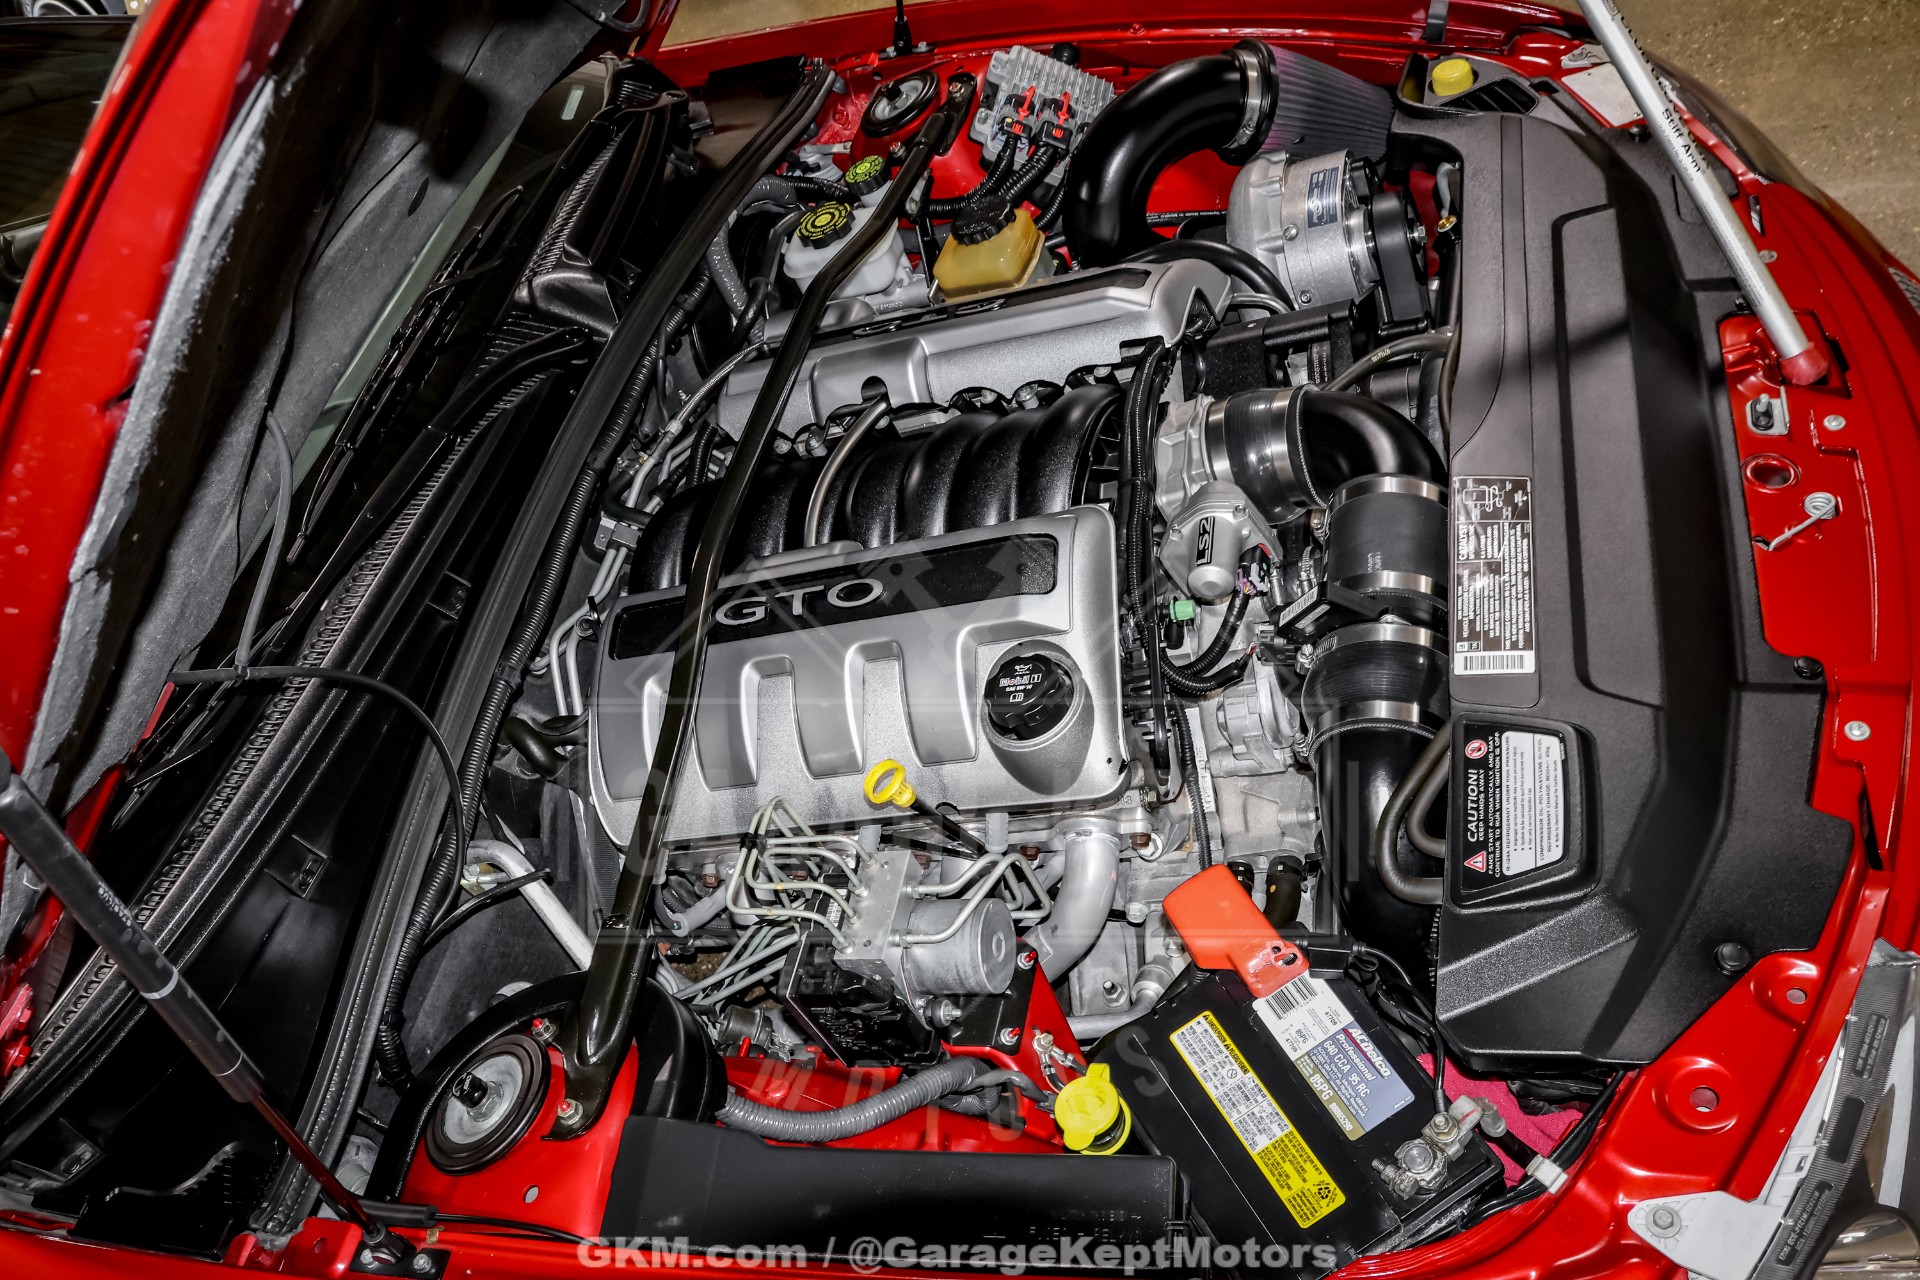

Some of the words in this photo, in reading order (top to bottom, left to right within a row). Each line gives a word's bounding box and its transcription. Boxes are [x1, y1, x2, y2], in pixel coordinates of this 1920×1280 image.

[1661, 107, 1684, 138] Stiff
[1680, 141, 1703, 172] Arm
[1194, 515, 1213, 565] LS2
[1458, 524, 1467, 560] CATALYST
[714, 577, 885, 629] GTO
[999, 674, 1030, 687] Mobil
[1494, 747, 1500, 755] IS
[1466, 768, 1479, 842] CAUTION!
[1494, 828, 1500, 837] TO
[1294, 1027, 1309, 1044] 85PG
[1323, 1010, 1338, 1026] 47709
[1284, 1037, 1298, 1053] 47709
[1334, 1032, 1376, 1082] Professional
[1347, 1027, 1392, 1078] ACDelco
[1307, 1071, 1334, 1101] 85PG
[1322, 1039, 1339, 1056] 640
[1332, 1052, 1352, 1073] CCA
[1347, 1071, 1361, 1086] 95
[1355, 1082, 1371, 1099] RC
